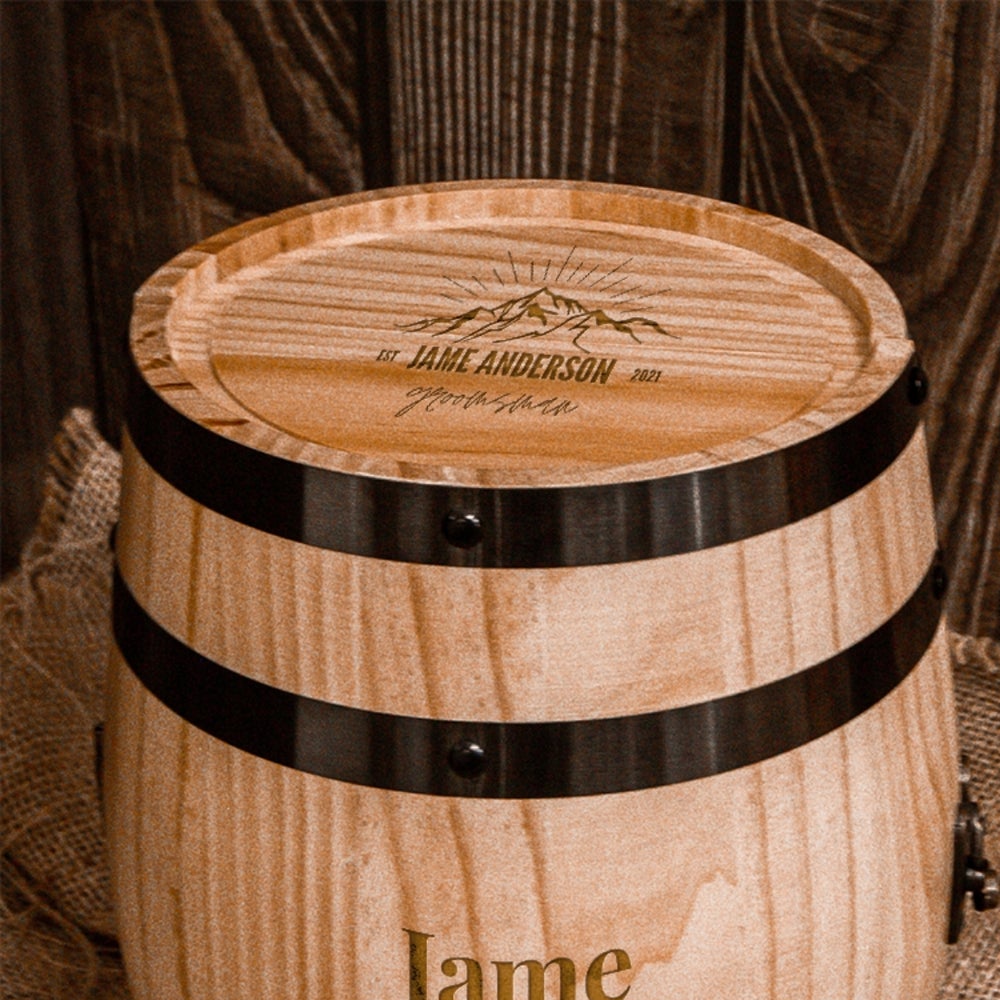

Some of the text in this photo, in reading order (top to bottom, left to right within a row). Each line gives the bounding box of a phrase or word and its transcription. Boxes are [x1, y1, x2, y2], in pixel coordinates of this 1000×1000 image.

[376, 345, 662, 385] EST JAME ANDERSON 2021
